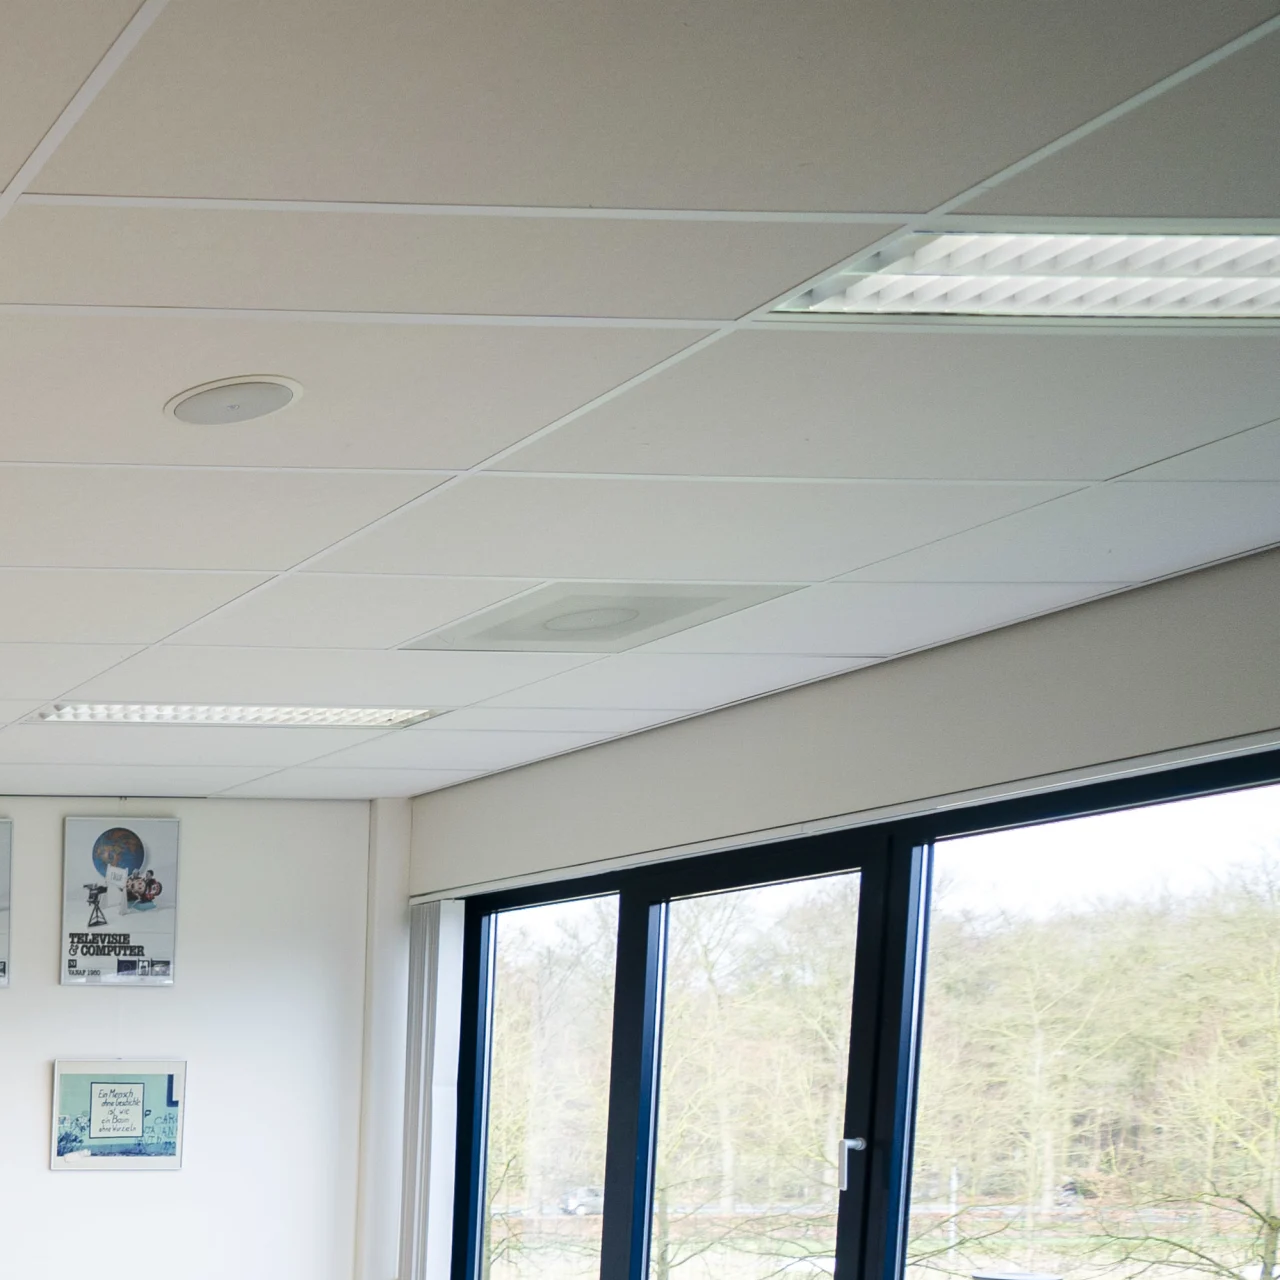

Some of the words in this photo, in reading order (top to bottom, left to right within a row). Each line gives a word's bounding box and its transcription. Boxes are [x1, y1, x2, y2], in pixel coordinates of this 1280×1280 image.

[69, 933, 130, 945] TELEVISIE
[69, 945, 79, 957] &
[80, 945, 145, 957] COMPUTER
[98, 1089, 108, 1098] Ein
[109, 1088, 133, 1098] Mensch
[101, 1098, 114, 1107] ohne
[99, 1124, 111, 1132] ohne
